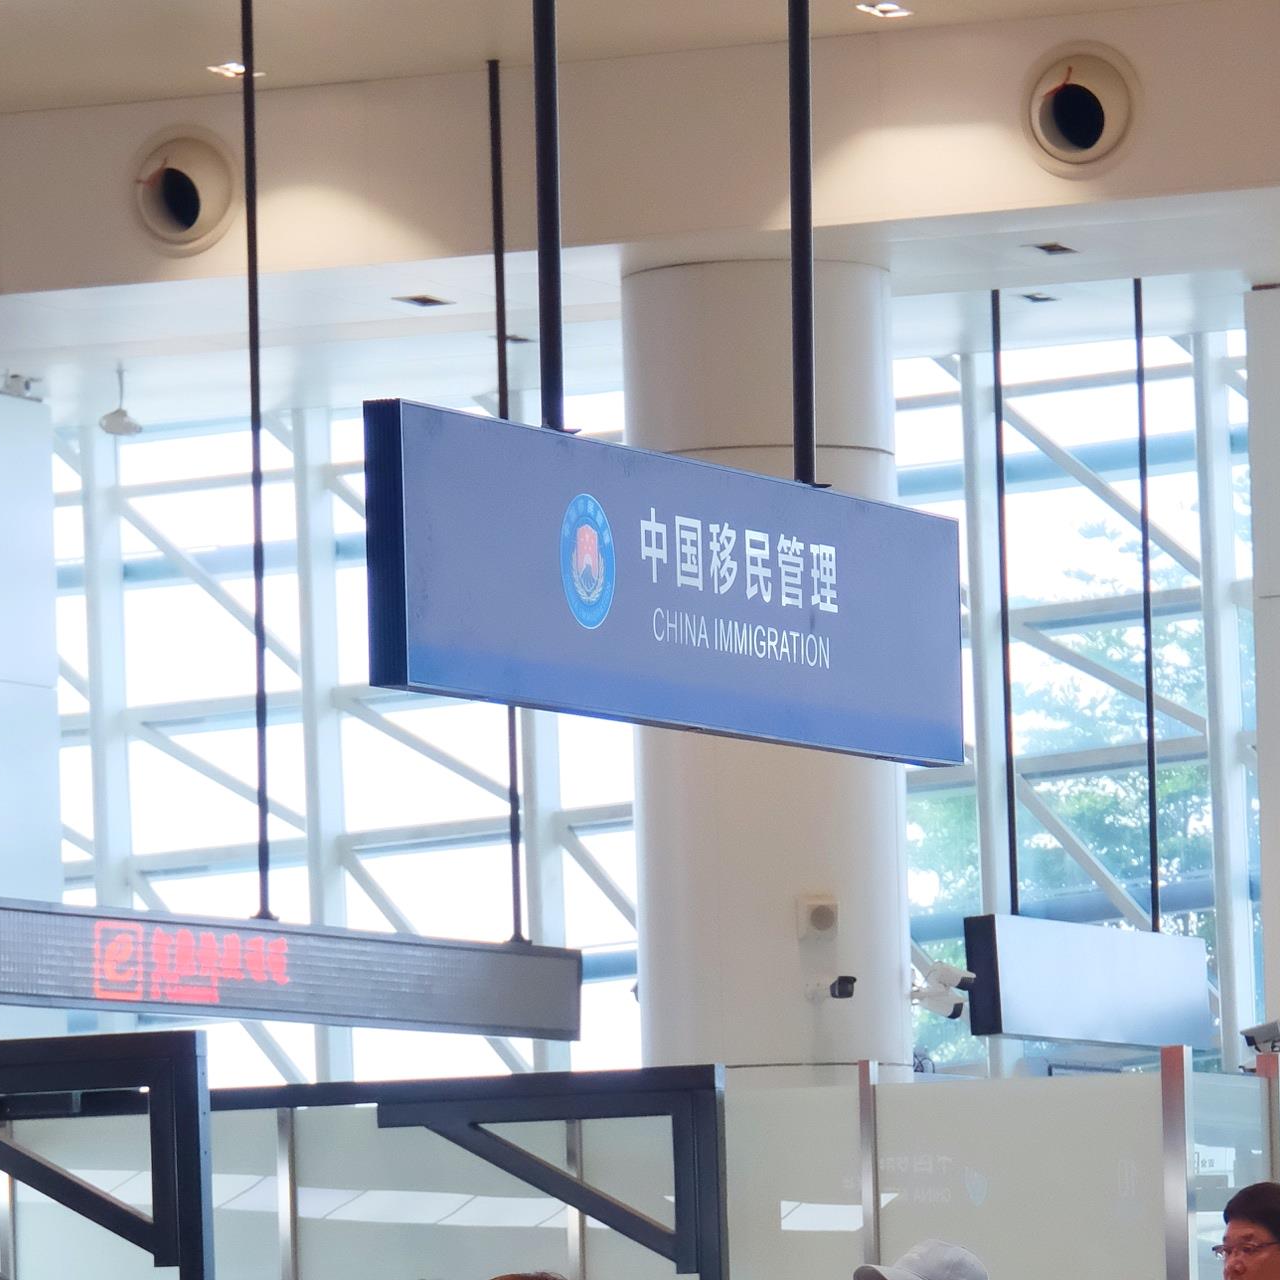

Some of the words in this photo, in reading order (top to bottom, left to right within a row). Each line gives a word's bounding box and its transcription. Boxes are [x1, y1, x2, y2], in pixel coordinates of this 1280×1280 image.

[640, 507, 838, 613] 中国移民管理
[653, 607, 709, 649] CHINA
[714, 618, 830, 669] IMMIGRATION
